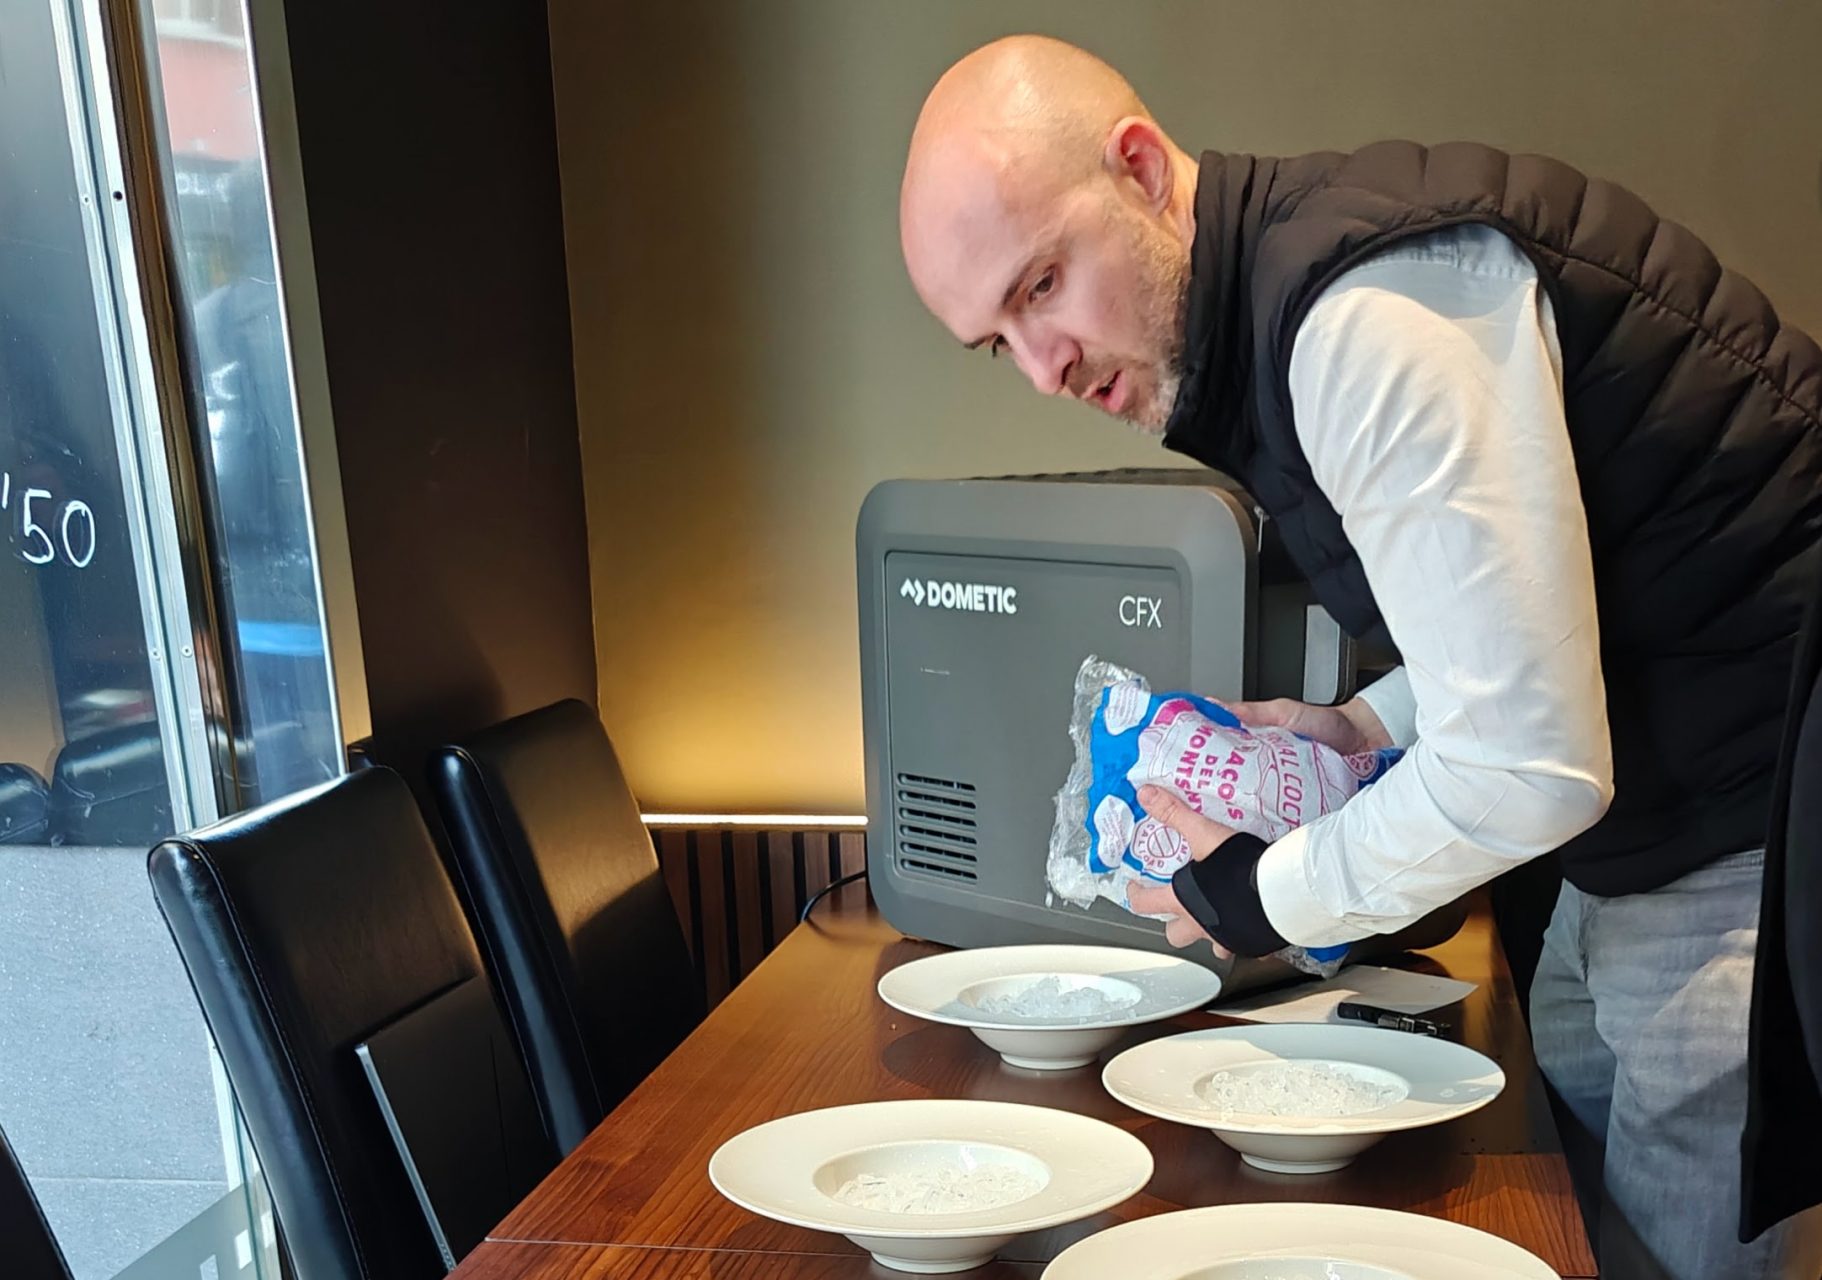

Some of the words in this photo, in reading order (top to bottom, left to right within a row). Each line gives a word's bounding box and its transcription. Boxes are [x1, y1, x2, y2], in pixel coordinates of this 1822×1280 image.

[927, 580, 1017, 614] DOMETIC
[1119, 595, 1162, 628] CFX
[1197, 755, 1218, 790] DEL
[1281, 773, 1303, 827] COCT
